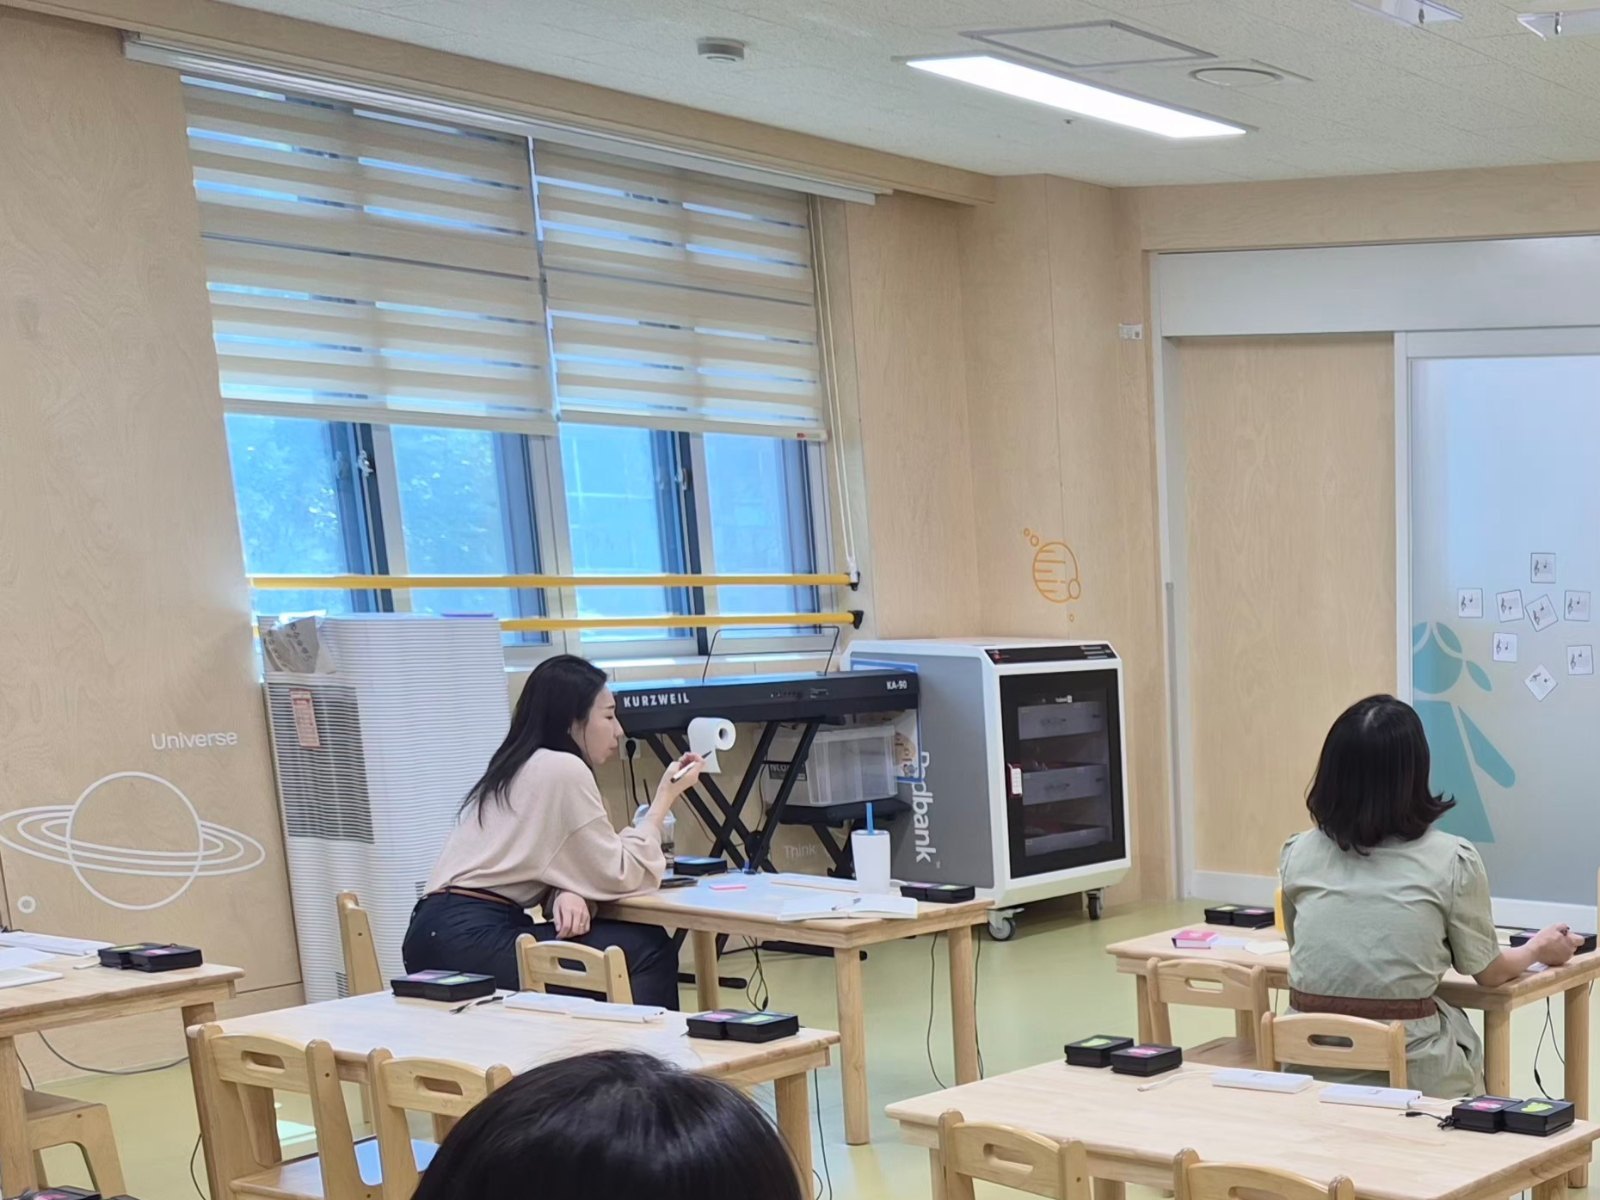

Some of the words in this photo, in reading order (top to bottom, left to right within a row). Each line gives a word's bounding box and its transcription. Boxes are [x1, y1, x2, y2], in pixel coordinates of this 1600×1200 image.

[623, 691, 690, 708] KURZWEIL
[886, 680, 908, 690] KA-90
[150, 730, 239, 751] Universe
